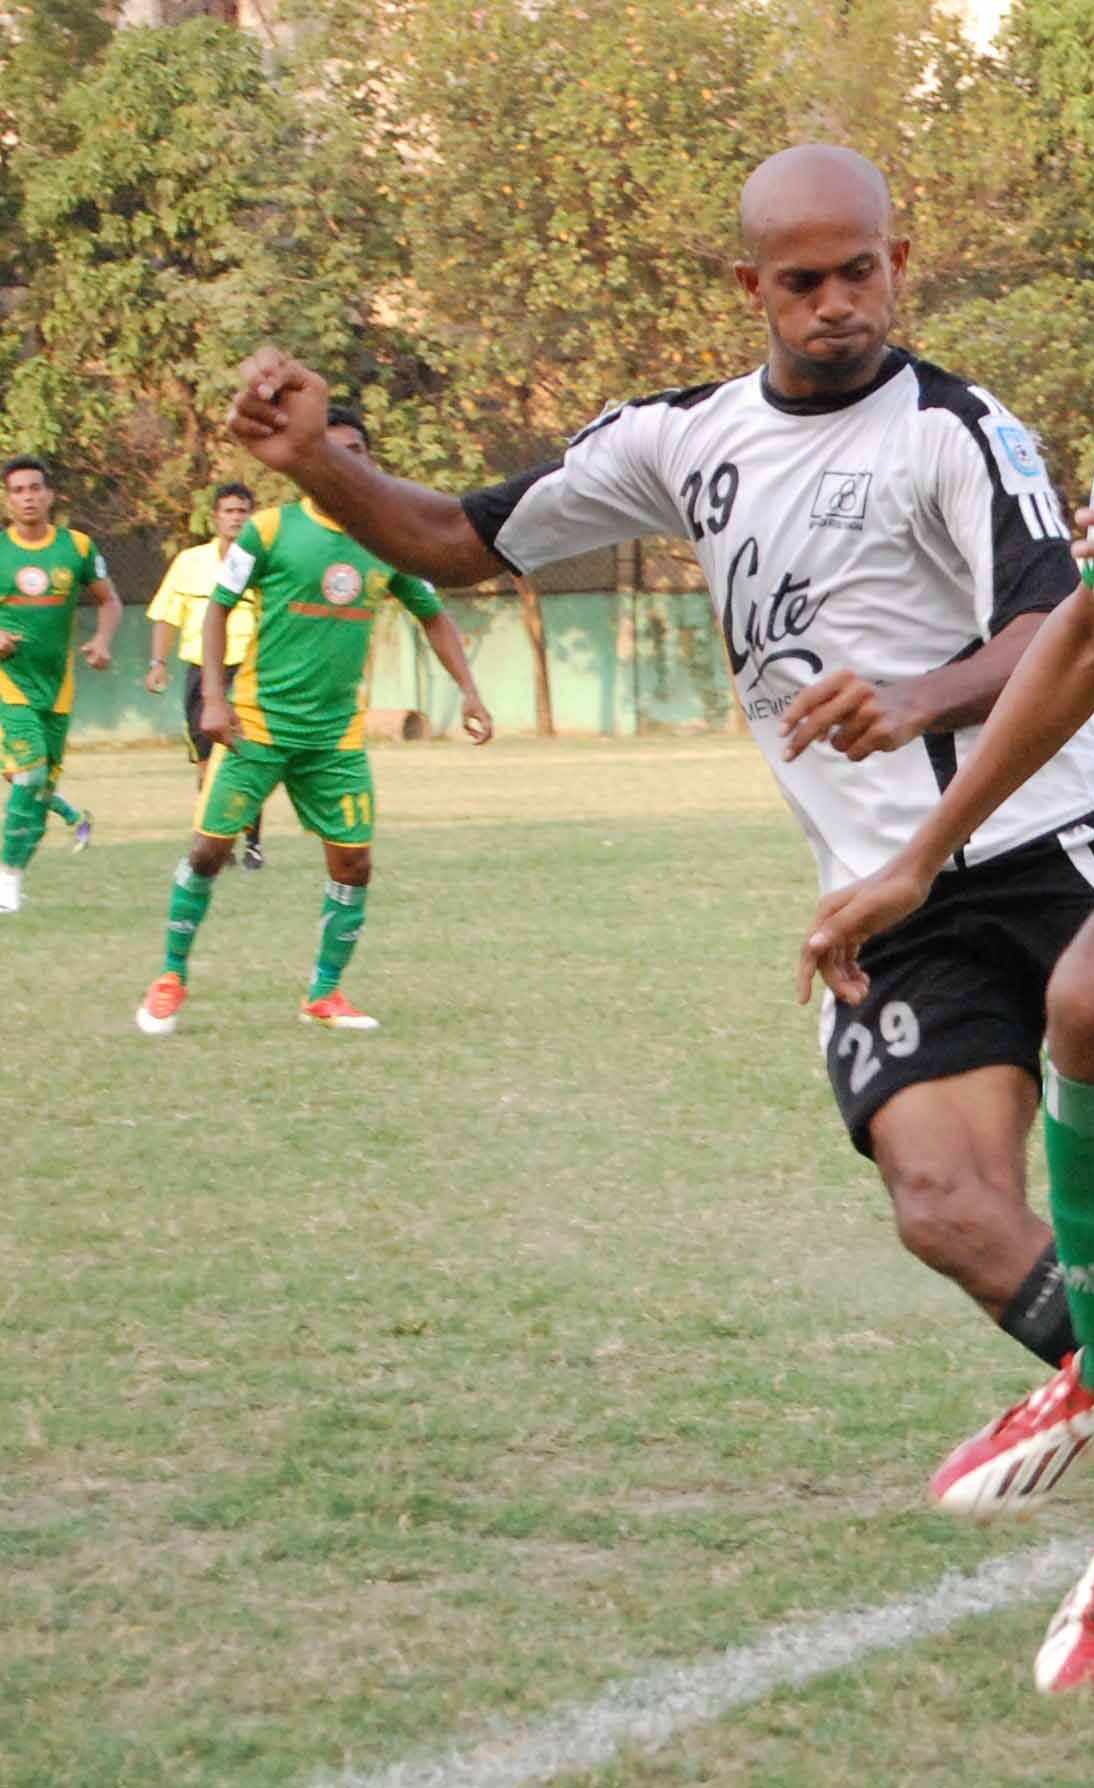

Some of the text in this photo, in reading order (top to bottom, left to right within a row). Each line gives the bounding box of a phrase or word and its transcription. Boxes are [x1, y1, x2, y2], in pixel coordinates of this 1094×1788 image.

[680, 462, 739, 541] 29
[723, 537, 830, 676] Cute
[340, 792, 370, 827] 11
[837, 1000, 920, 1094] 29
